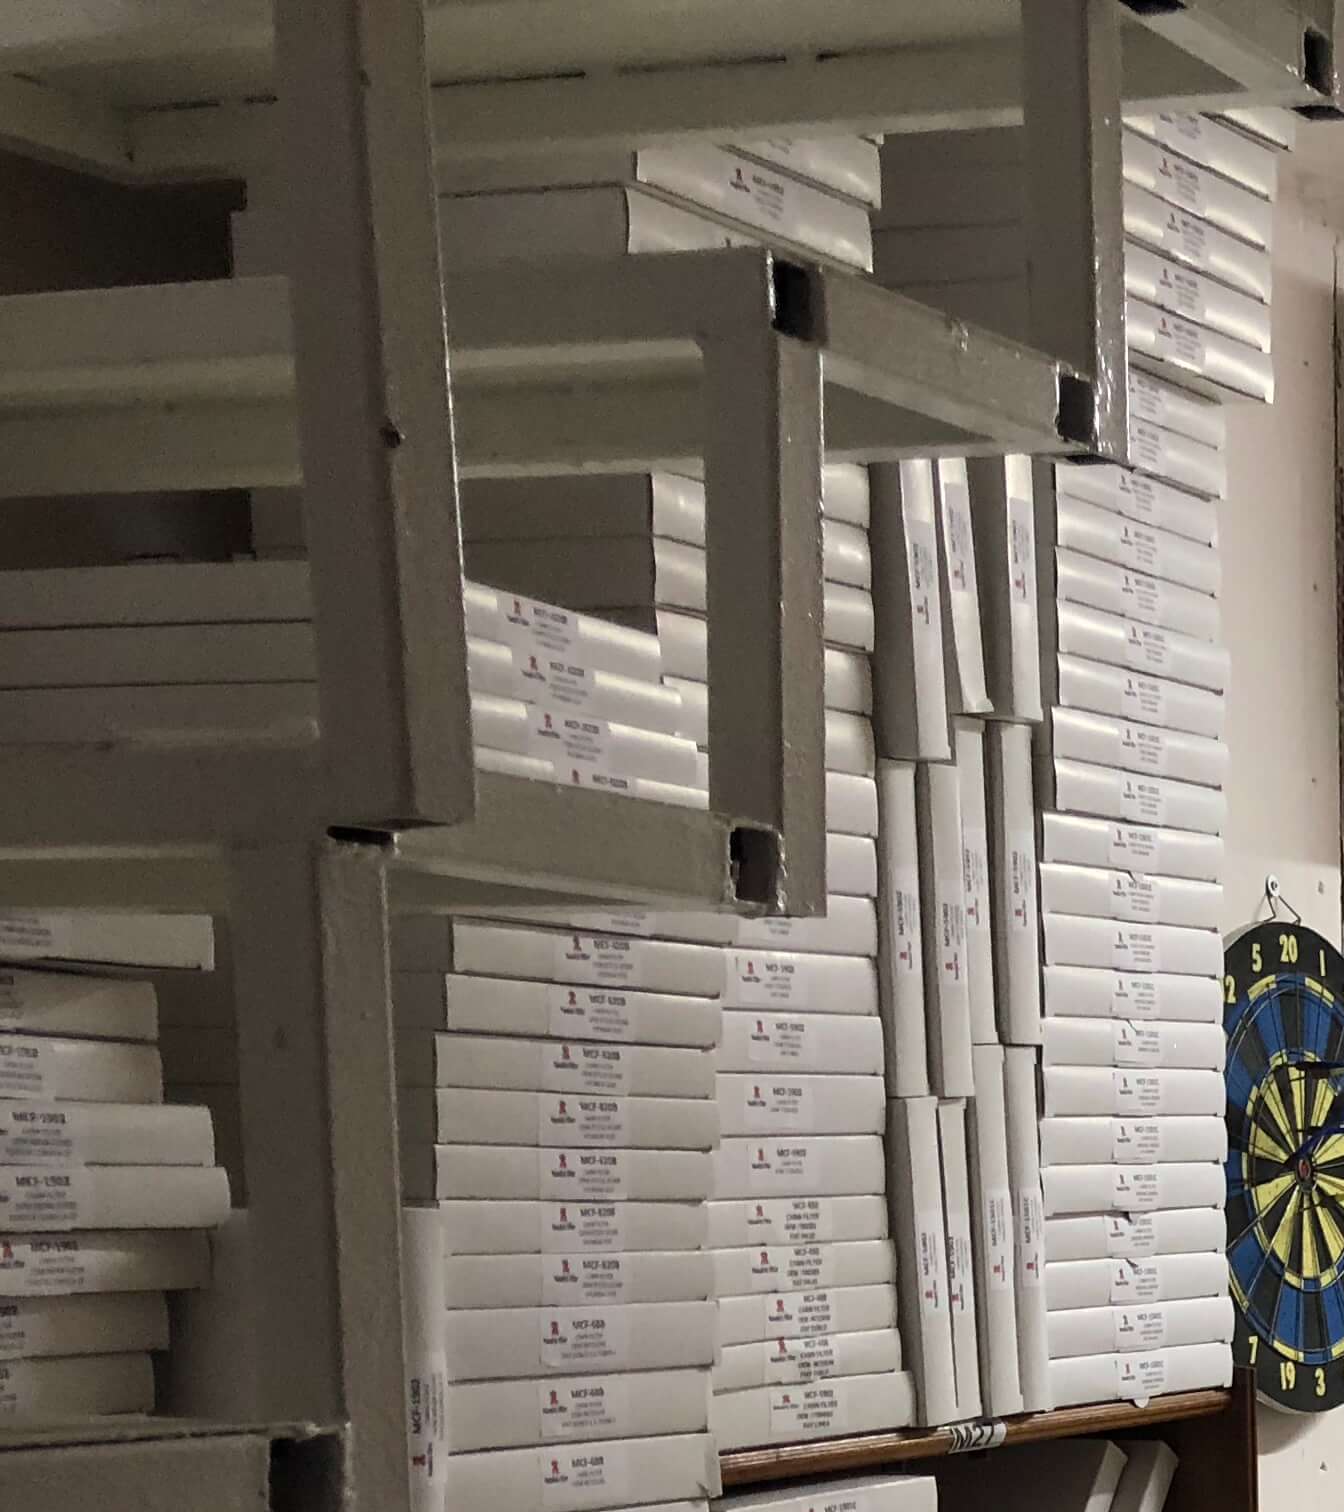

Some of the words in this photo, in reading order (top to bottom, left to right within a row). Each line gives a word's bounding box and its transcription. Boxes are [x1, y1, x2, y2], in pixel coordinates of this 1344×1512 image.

[1252, 943, 1264, 973] 5
[1279, 933, 1299, 963] 20
[1319, 949, 1326, 976] 1
[1248, 1336, 1258, 1364] 7
[1280, 1361, 1296, 1391] 19
[1315, 1367, 1327, 1397] 3
[951, 1423, 994, 1452] M27
